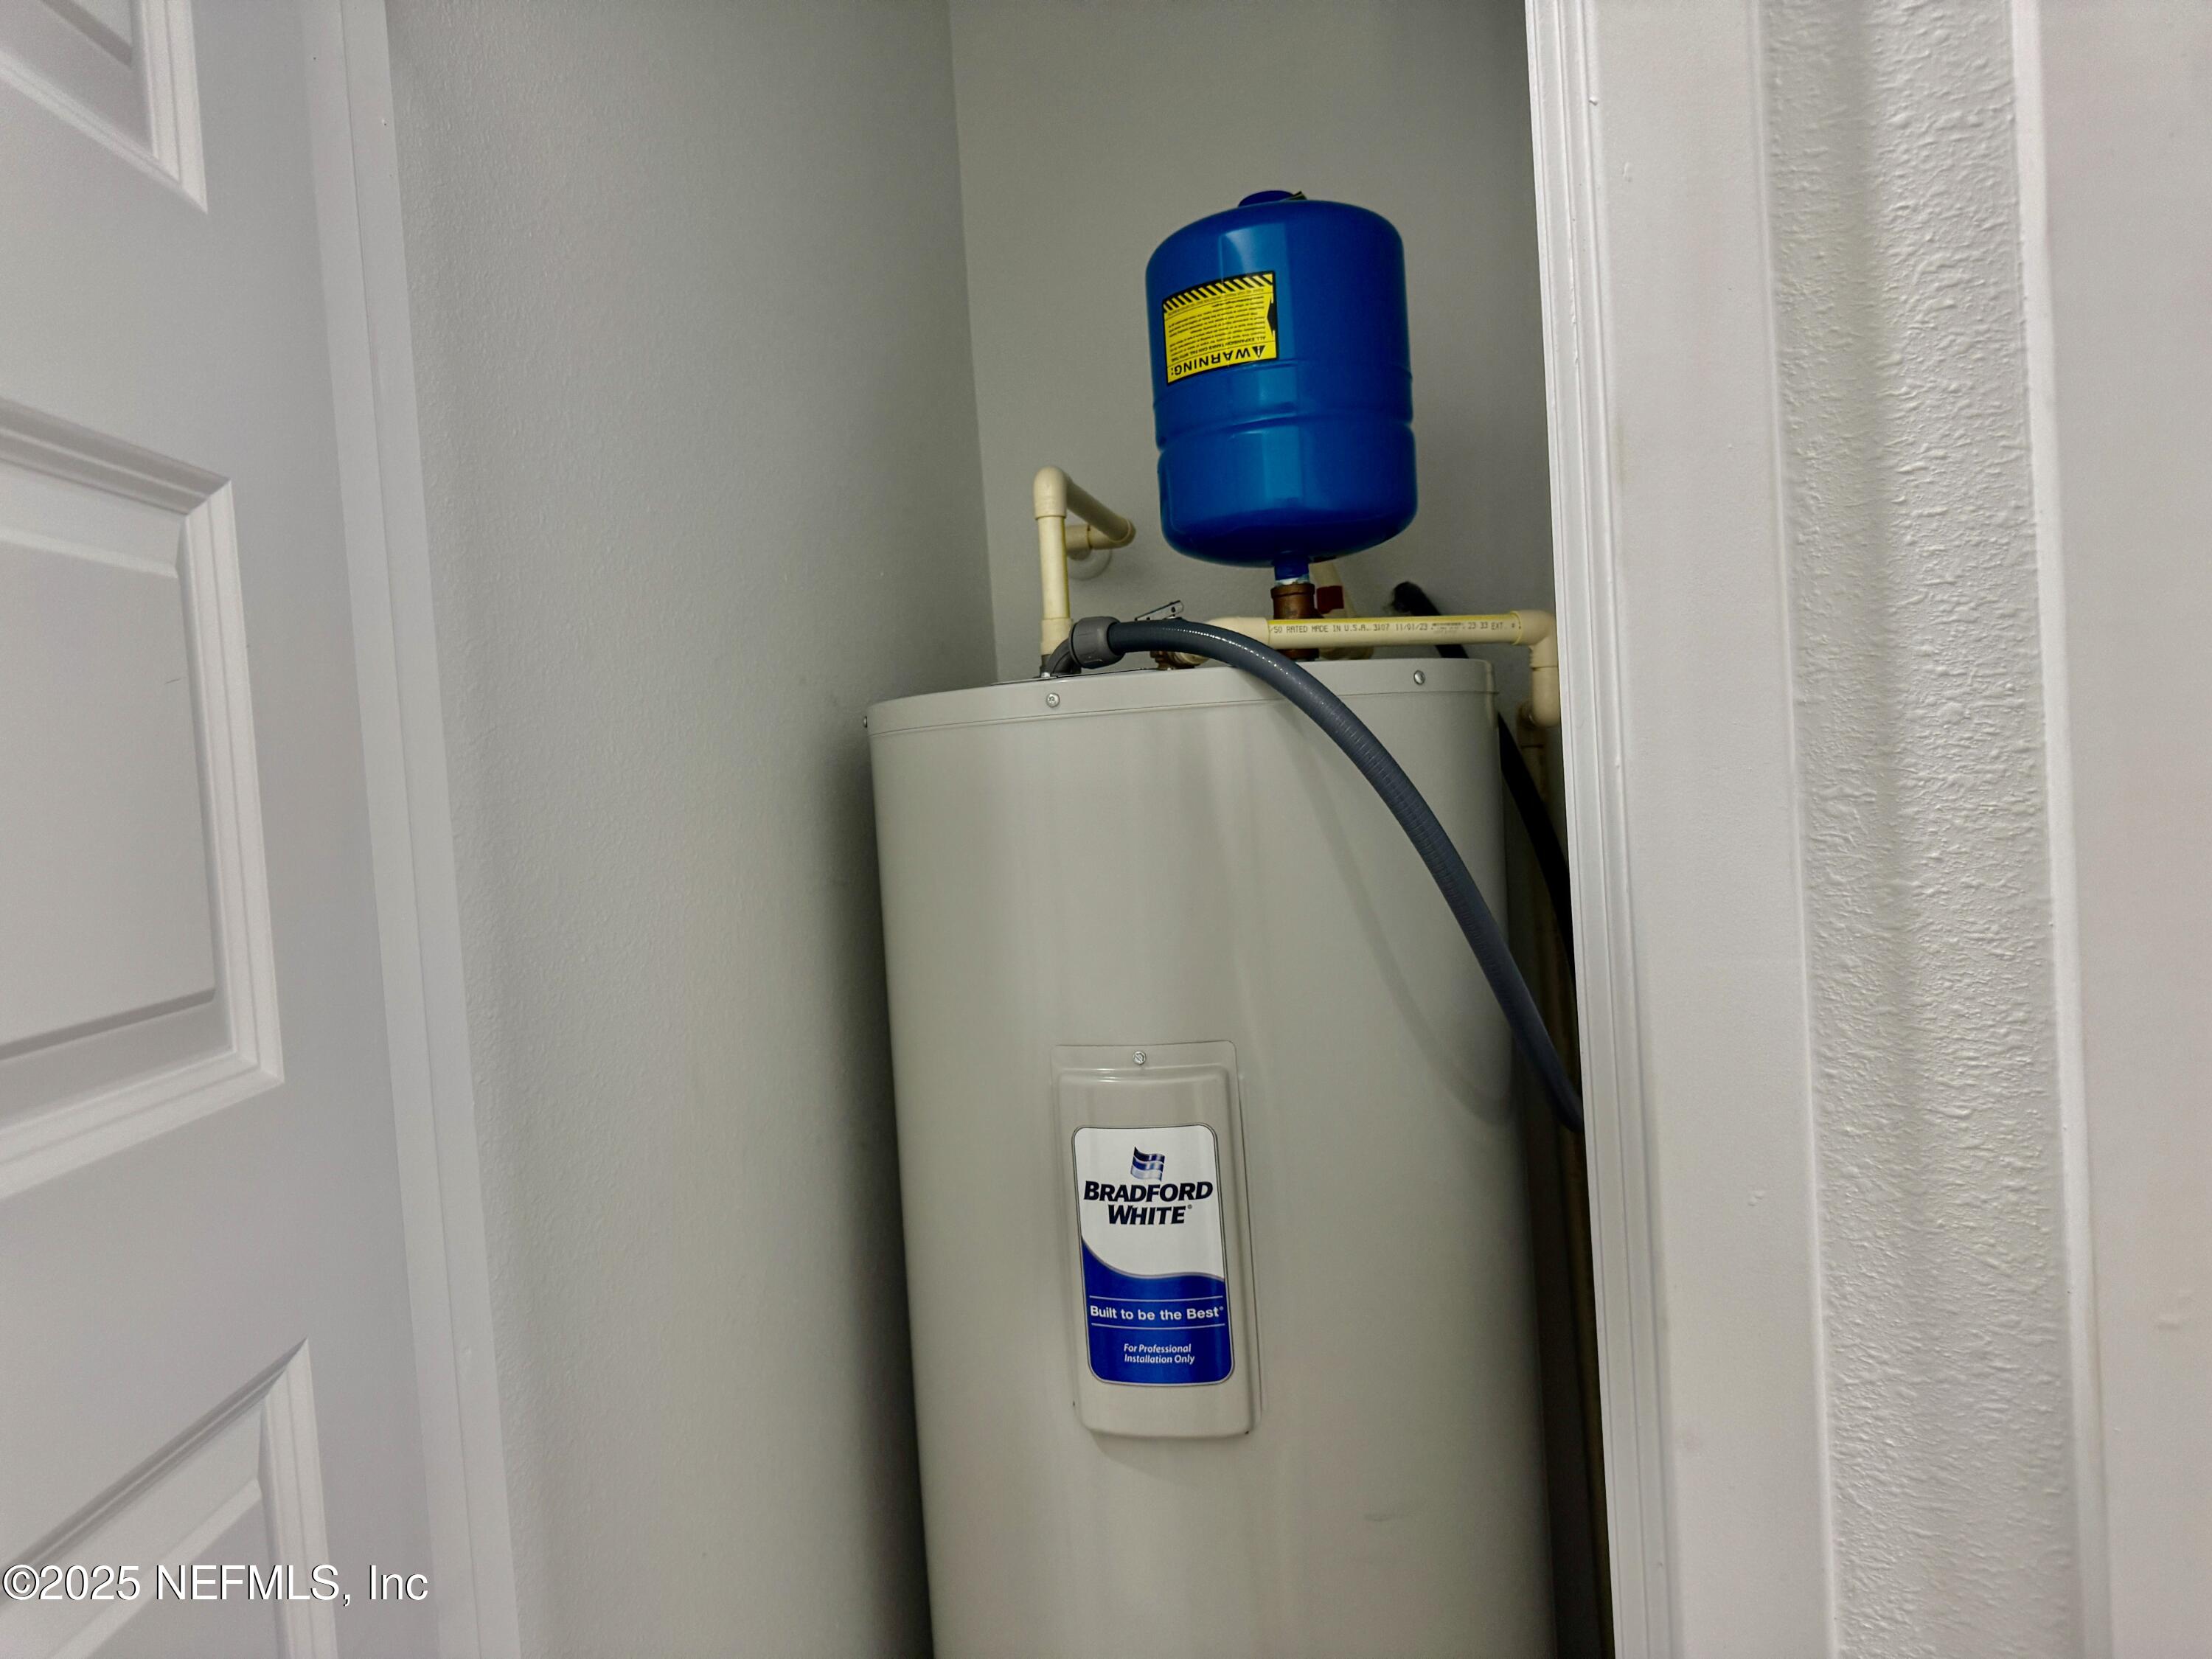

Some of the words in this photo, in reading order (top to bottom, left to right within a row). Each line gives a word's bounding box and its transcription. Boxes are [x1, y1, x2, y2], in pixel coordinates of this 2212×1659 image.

[1170, 347, 1251, 376] WARNING:
[1311, 625, 1329, 633] MADE
[1084, 1181, 1213, 1202] BRADFORD
[1090, 1305, 1118, 1320] Built
[1121, 1309, 1134, 1321] to
[1138, 1308, 1155, 1321] be
[1160, 1309, 1182, 1321] the
[1124, 1343, 1138, 1353] For
[1138, 1343, 1192, 1354] Professional
[1124, 1353, 1172, 1363] Installation
[1174, 1354, 1195, 1365] Only
